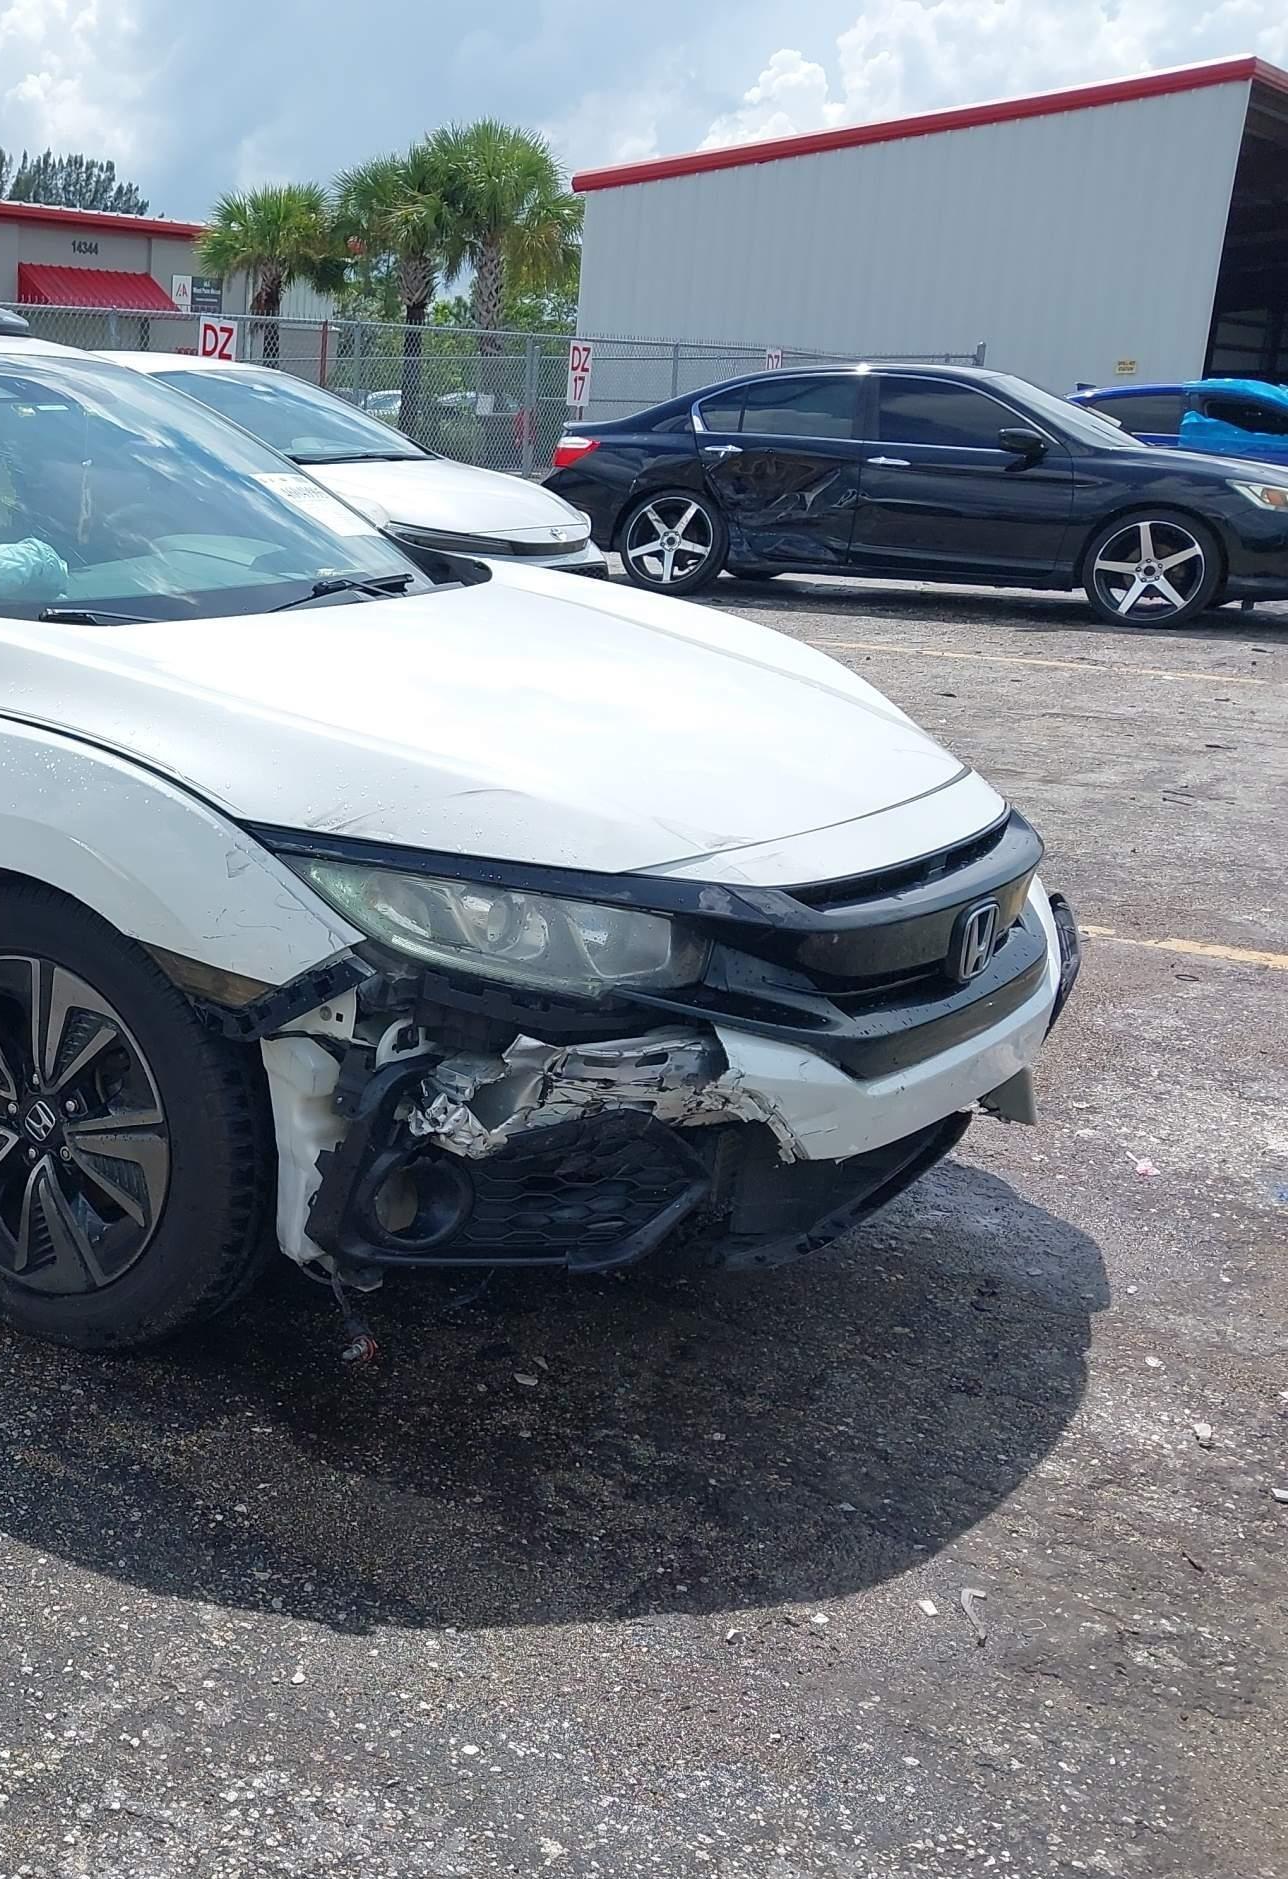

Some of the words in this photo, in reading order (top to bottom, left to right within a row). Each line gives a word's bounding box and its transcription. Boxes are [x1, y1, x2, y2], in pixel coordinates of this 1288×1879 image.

[71, 239, 98, 256] 14344
[202, 323, 234, 360] DZ
[571, 345, 592, 373] DZ
[573, 375, 586, 401] 17
